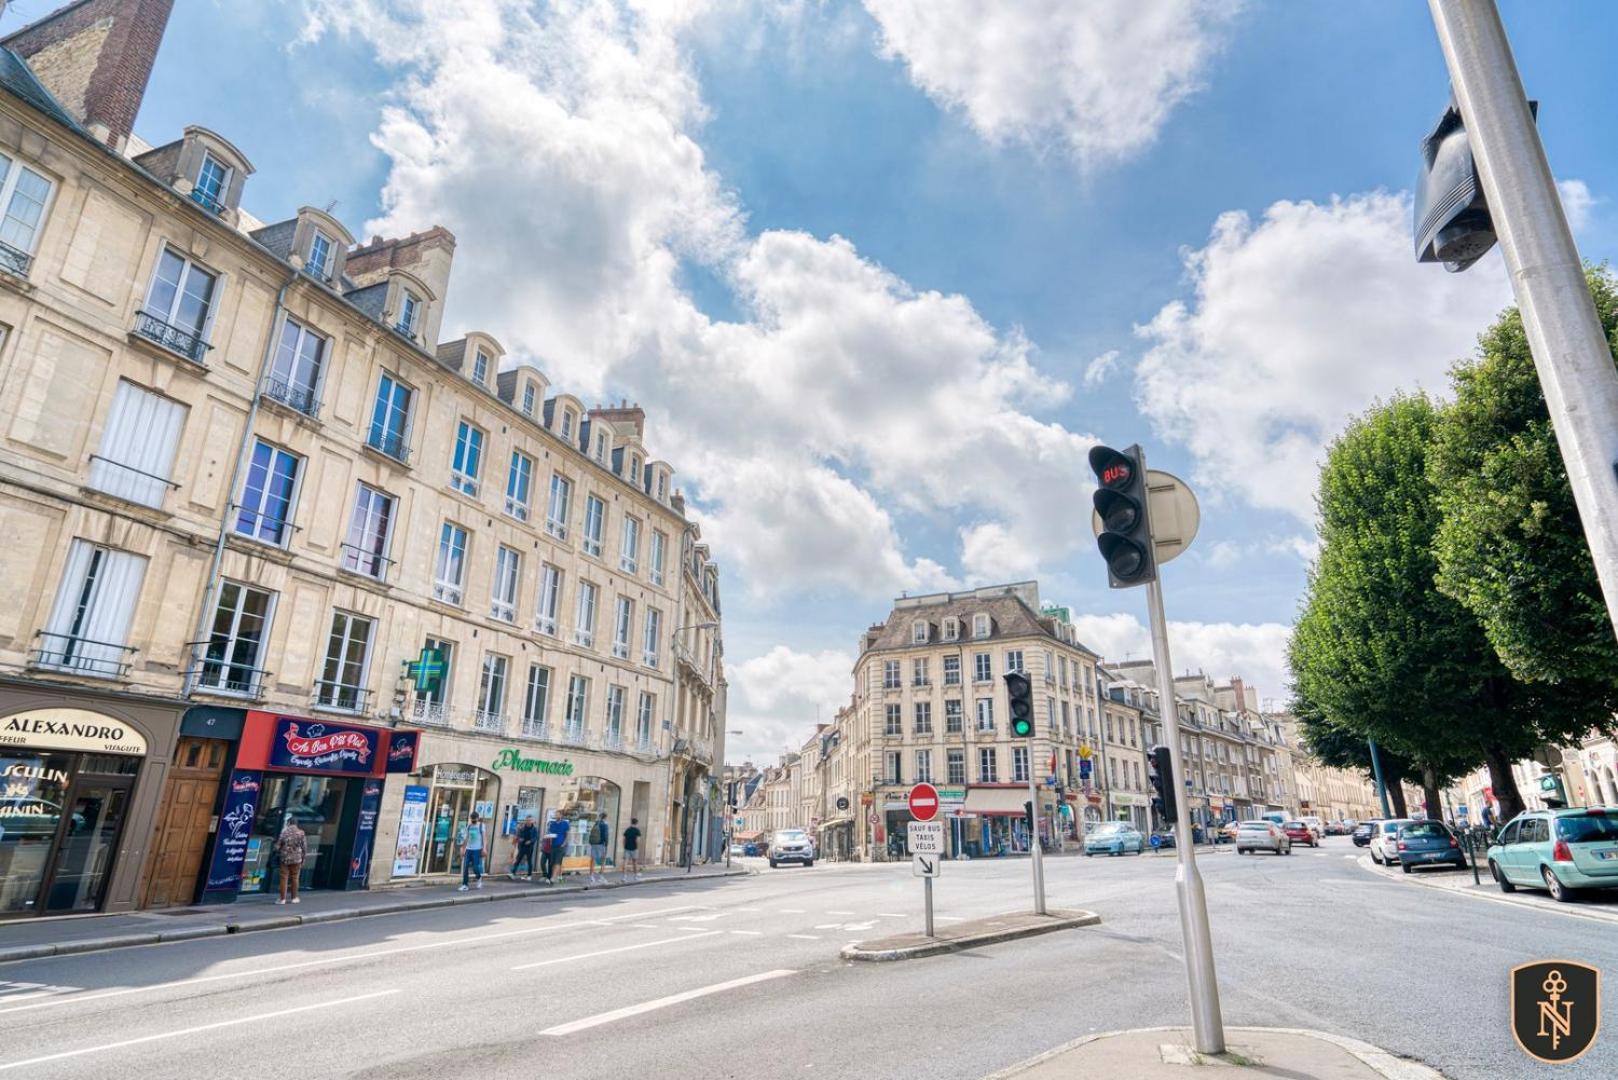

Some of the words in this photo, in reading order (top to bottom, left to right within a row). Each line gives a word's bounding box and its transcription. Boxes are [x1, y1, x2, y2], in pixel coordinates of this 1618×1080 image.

[1103, 463, 1129, 483] BUS
[4, 718, 124, 740] ALEXANDRO
[492, 749, 575, 776] Pharmacie
[915, 842, 936, 850] VÉLOS
